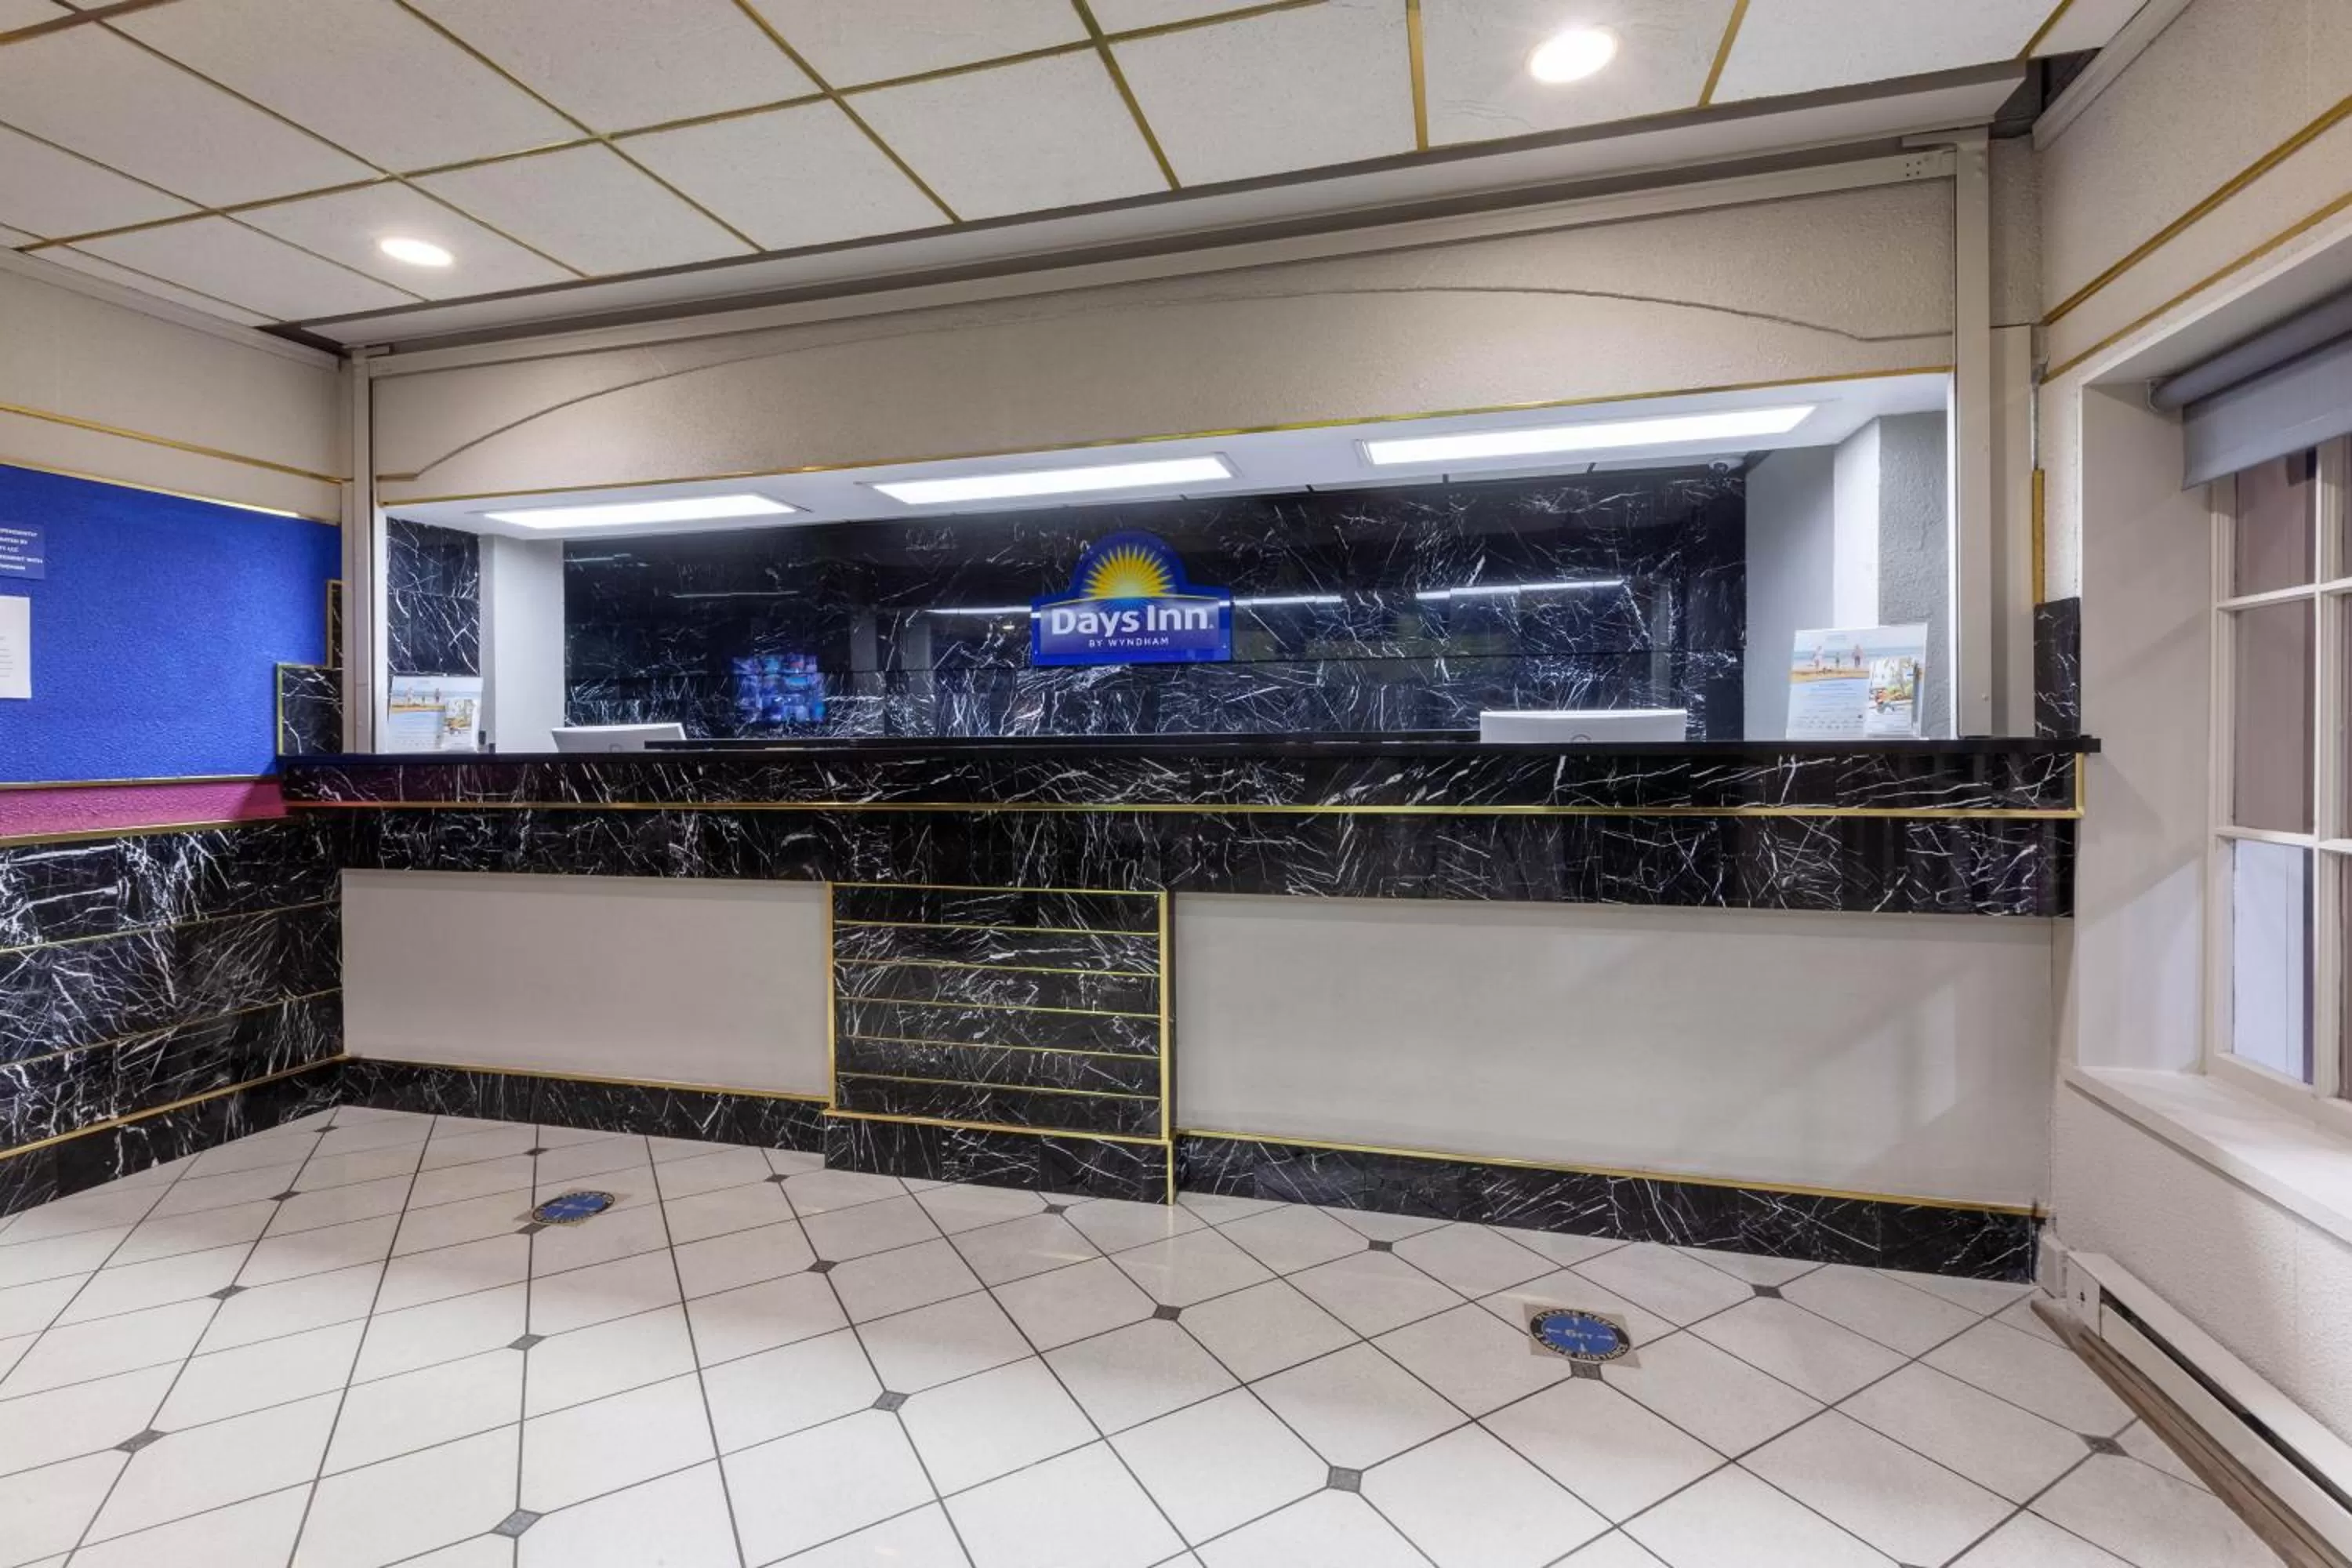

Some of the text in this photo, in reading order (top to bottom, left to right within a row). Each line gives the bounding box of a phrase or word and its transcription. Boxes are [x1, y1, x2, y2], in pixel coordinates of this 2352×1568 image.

[1051, 605, 1209, 637] Days Inn
[1108, 637, 1170, 647] WYNDHAM
